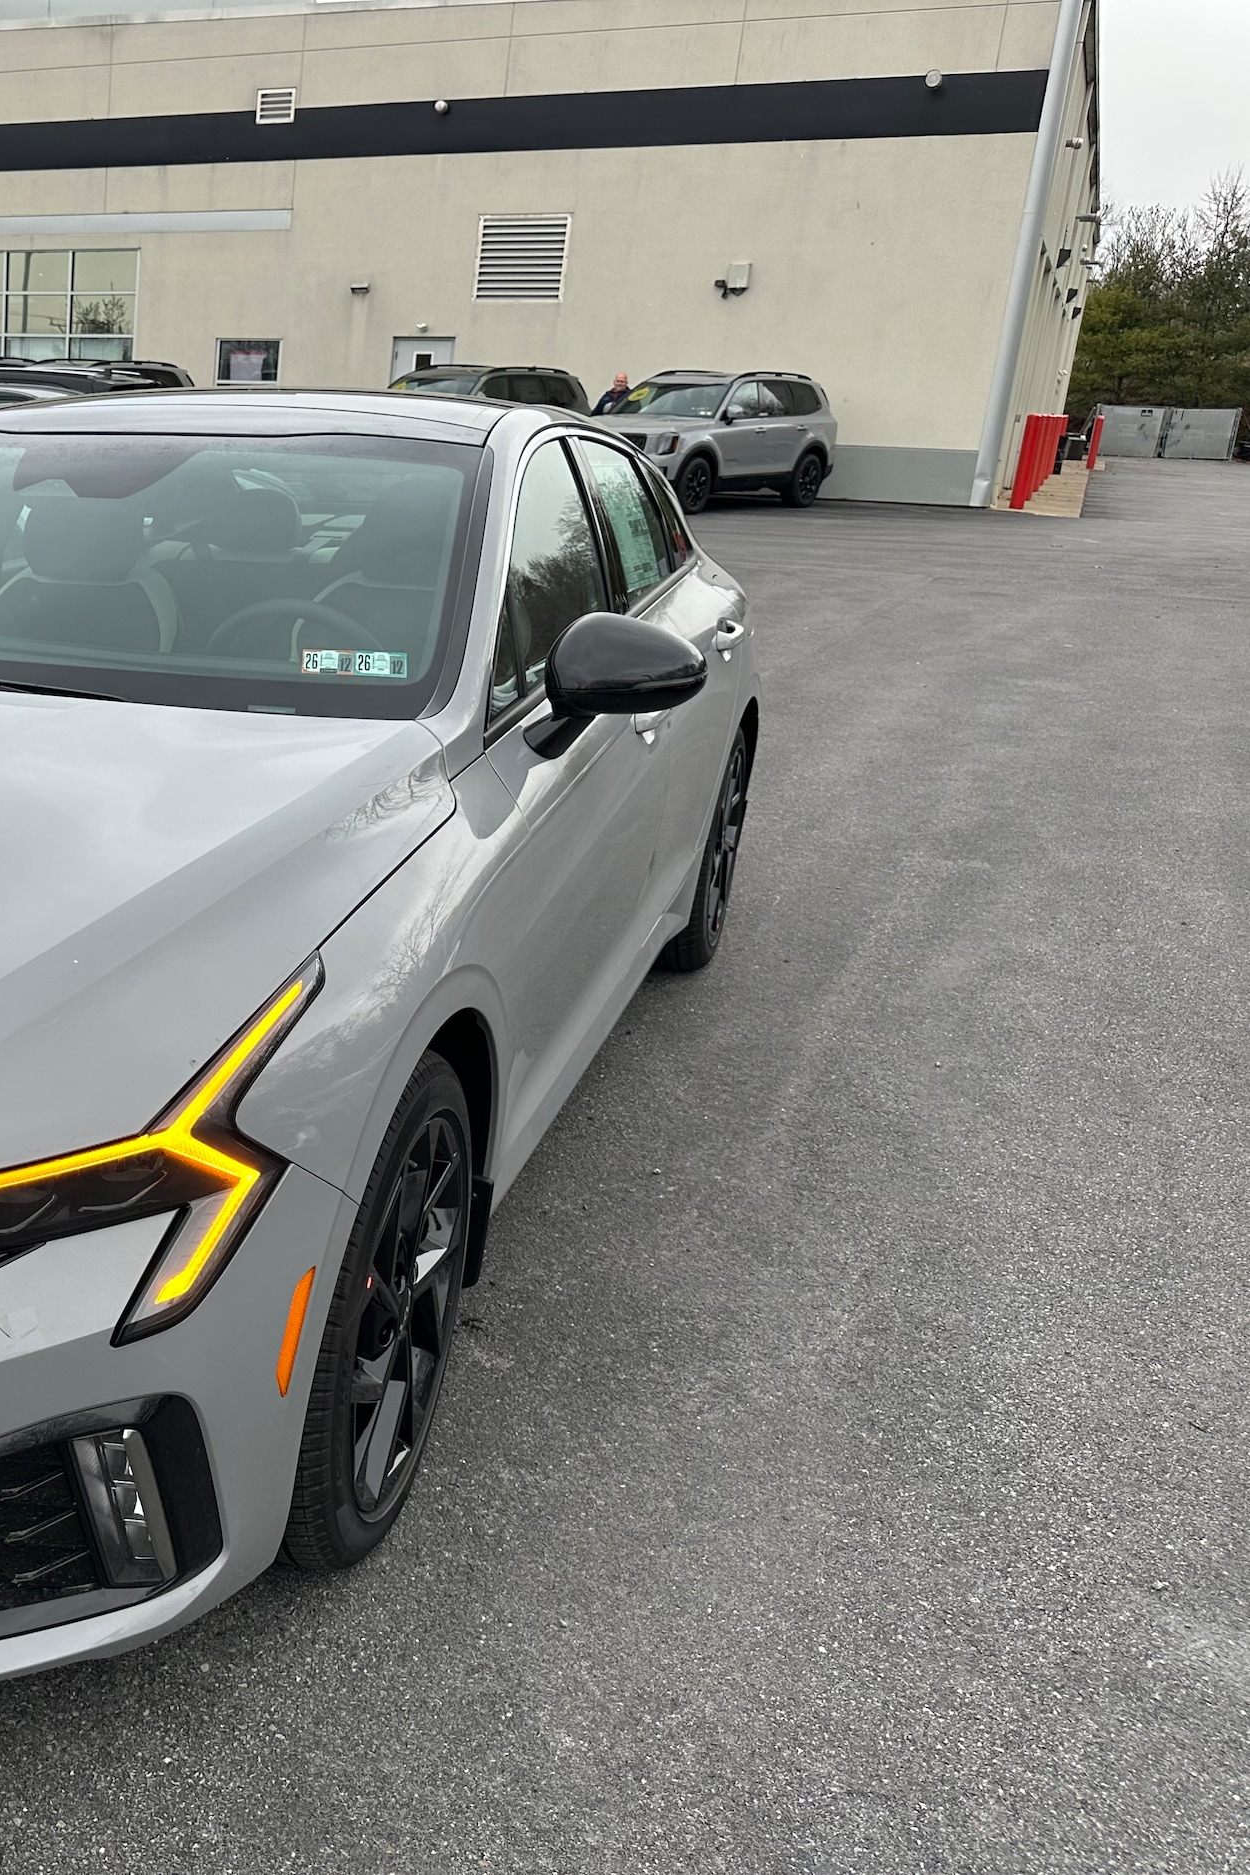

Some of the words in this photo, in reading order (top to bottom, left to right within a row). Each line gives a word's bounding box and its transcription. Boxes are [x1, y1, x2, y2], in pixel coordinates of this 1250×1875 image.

[305, 653, 318, 670] 26
[339, 657, 352, 672] 12
[358, 654, 371, 671] 26
[391, 660, 404, 675] 12
